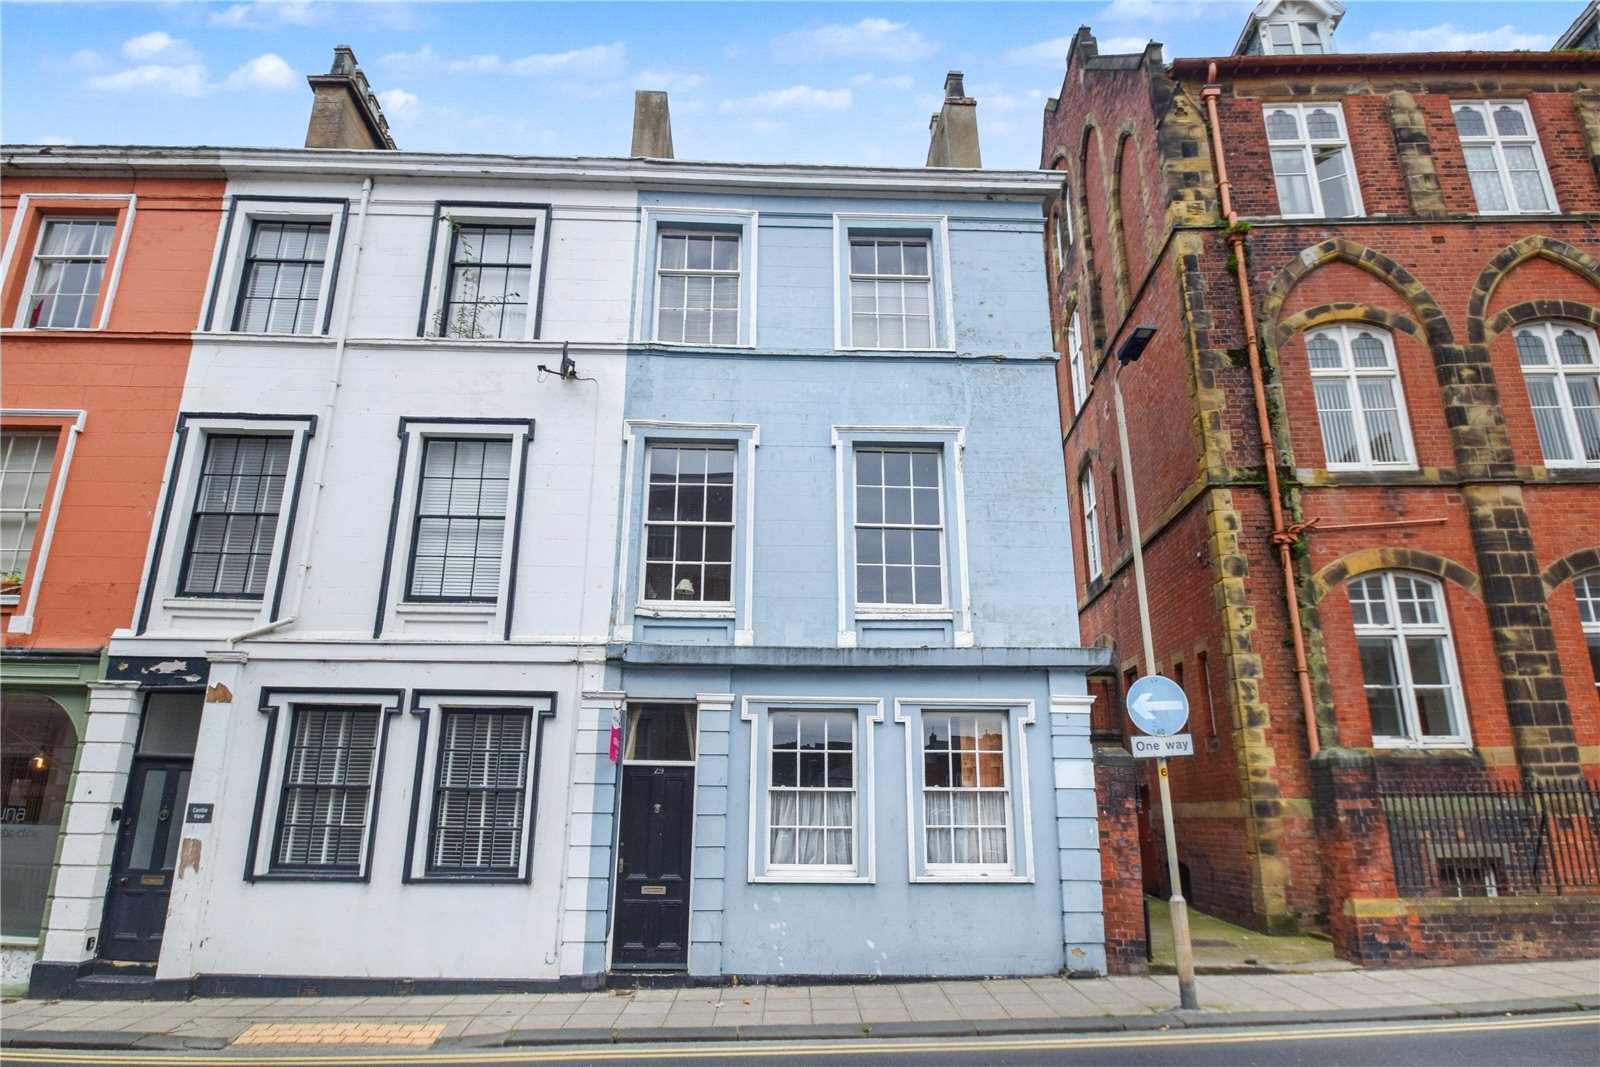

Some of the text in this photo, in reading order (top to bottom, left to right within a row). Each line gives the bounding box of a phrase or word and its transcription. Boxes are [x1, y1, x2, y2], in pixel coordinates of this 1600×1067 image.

[1136, 741, 1188, 751] One way
[1160, 767, 1167, 777] 6
